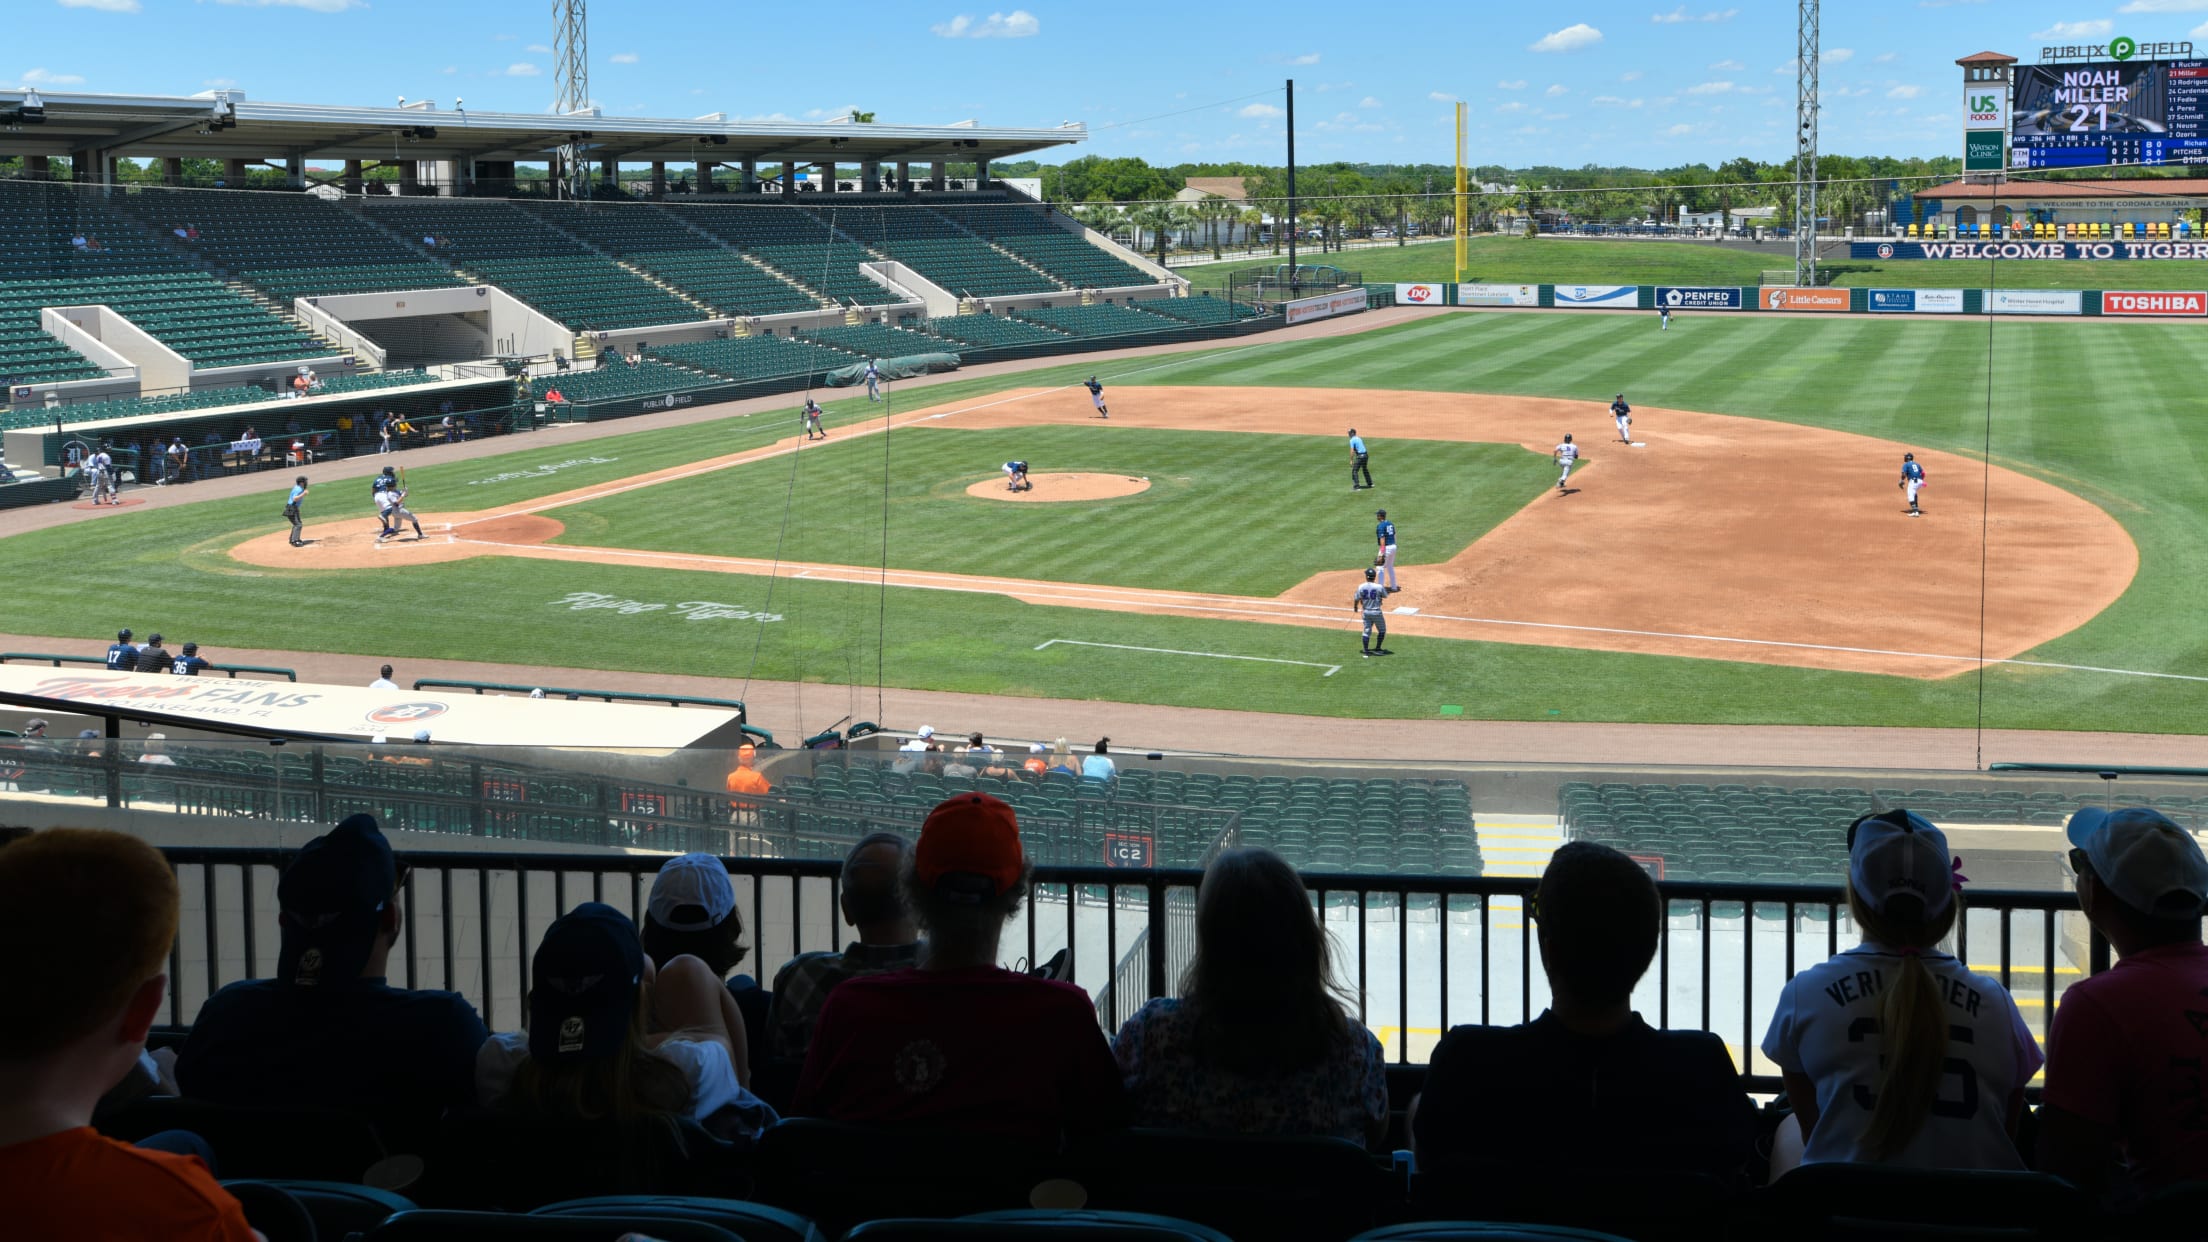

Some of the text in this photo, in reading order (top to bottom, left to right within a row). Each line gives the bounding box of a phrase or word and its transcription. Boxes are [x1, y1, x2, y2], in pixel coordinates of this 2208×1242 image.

[2042, 44, 2105, 59] PUBLIX
[2141, 41, 2193, 56] FIELD
[2064, 70, 2119, 87] NOAH
[2054, 87, 2129, 104] MILLER
[1970, 113, 1997, 121] FOODS
[2069, 103, 2107, 132] 21
[1920, 243, 2065, 259] WELCOME
[2076, 243, 2114, 259] TO
[2125, 243, 2208, 259] TIGER
[1411, 288, 1429, 299] DQ
[1684, 292, 1730, 301] PENFED
[1790, 295, 1842, 305] Little Caesars
[2110, 296, 2200, 310] TOSHIBA
[643, 395, 692, 409] PUBLIX FIELD
[1362, 589, 1377, 600] 26
[668, 601, 785, 623] Tigers
[107, 650, 121, 663] 17
[174, 662, 188, 675] 36
[176, 677, 273, 688] WELCOME
[188, 688, 324, 708] FANS
